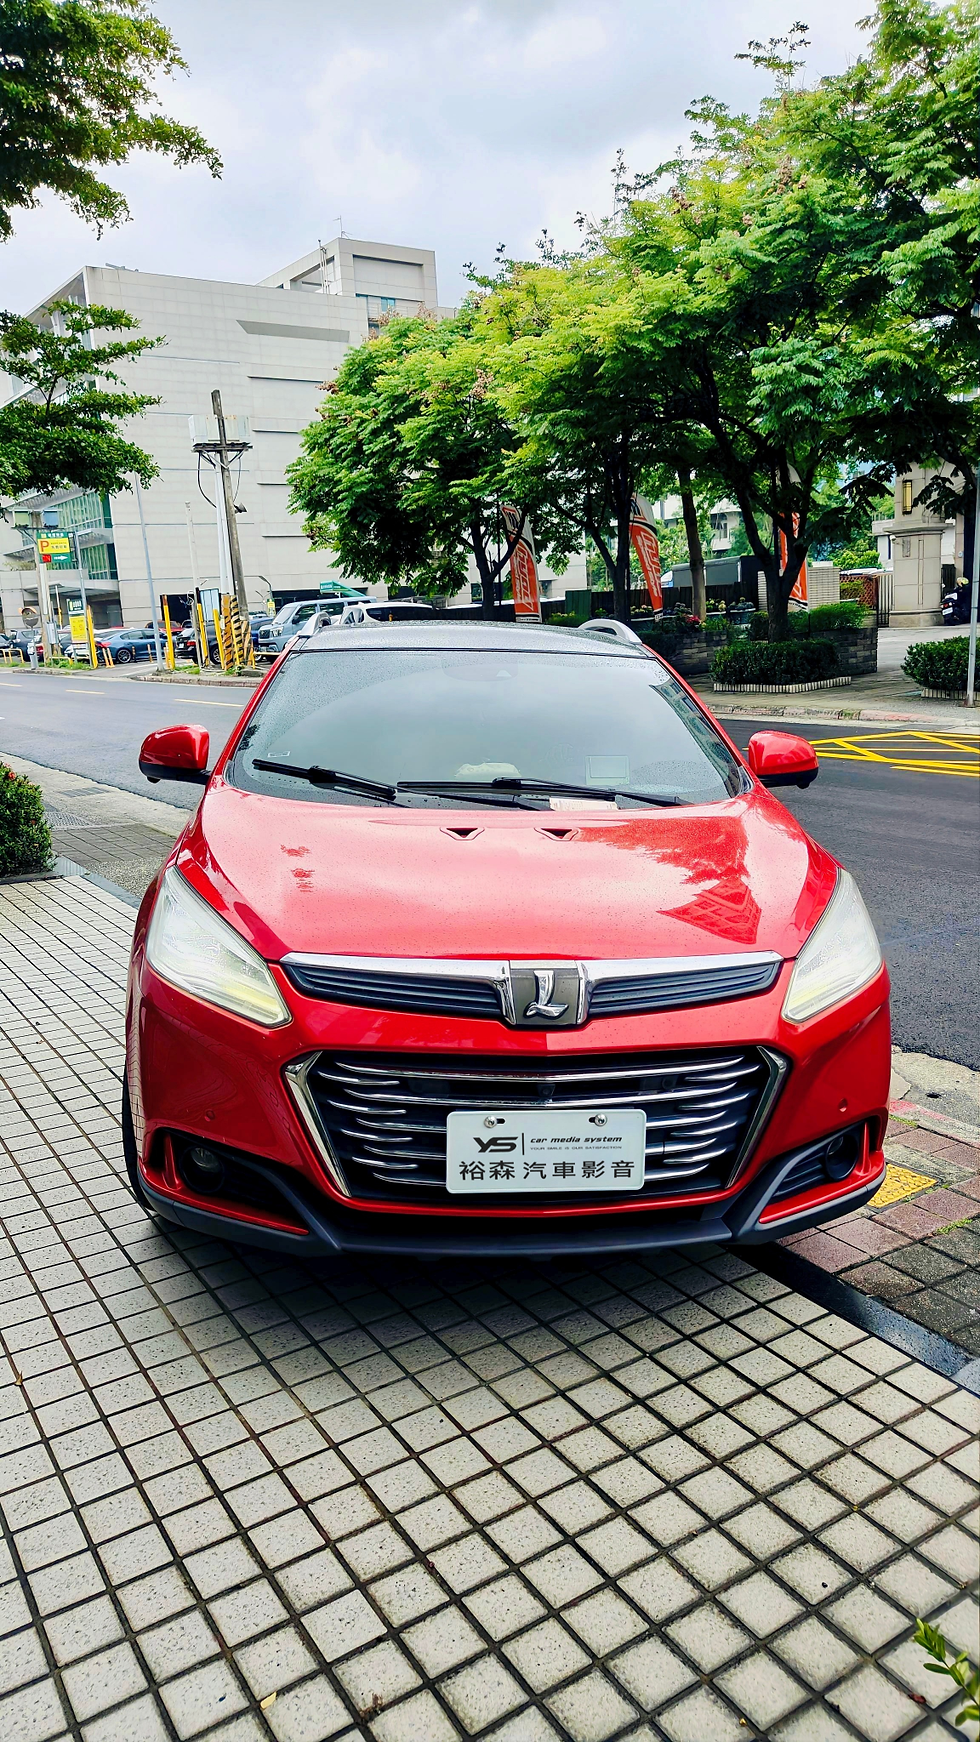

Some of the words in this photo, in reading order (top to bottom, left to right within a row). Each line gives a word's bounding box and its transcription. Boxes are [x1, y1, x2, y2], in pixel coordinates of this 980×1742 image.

[40, 540, 50, 552] P
[473, 1136, 519, 1153] YS
[583, 1136, 622, 1144] system
[459, 1160, 635, 1181] 裕森汽車影音
